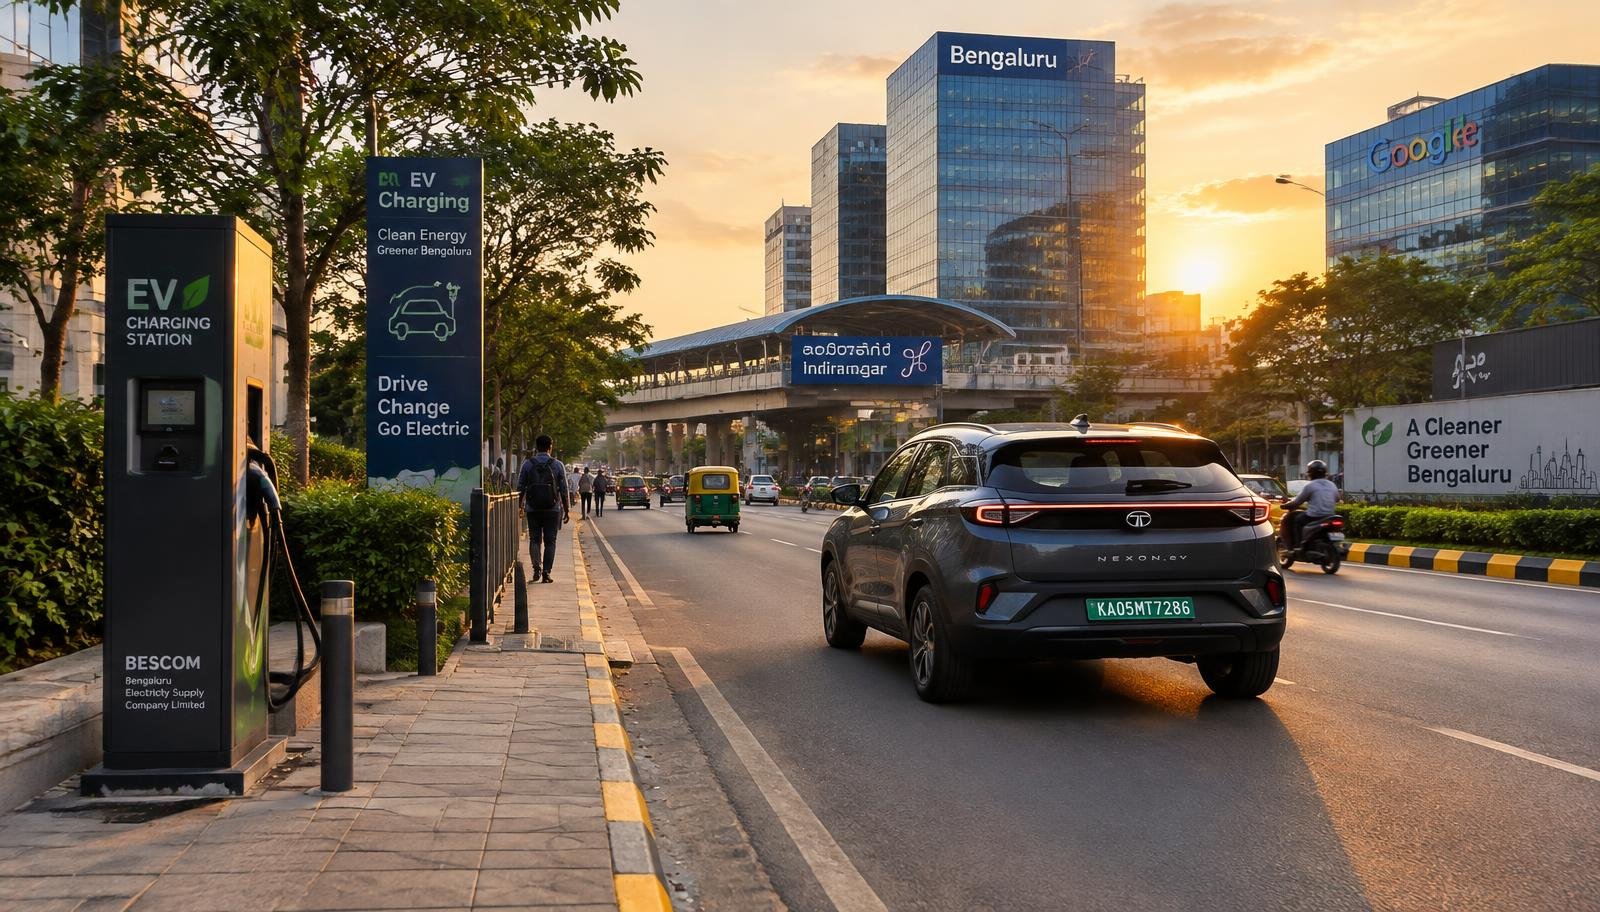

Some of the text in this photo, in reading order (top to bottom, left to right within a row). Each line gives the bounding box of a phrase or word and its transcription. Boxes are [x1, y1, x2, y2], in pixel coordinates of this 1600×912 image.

[950, 45, 1057, 70] Bengaluru
[410, 171, 437, 188] EV
[378, 191, 470, 213] Charging
[377, 228, 467, 245] Clean Energy
[377, 245, 419, 255] Greener
[127, 279, 178, 311] EV
[126, 316, 211, 330] CHARGING
[126, 333, 192, 346] STATION
[378, 374, 428, 392] Drive
[377, 398, 450, 419] Change
[377, 421, 470, 436] Go Electric
[1406, 417, 1502, 436] A Cleaner
[1407, 441, 1490, 459] Greener
[1408, 464, 1512, 488] Bengaluru
[1097, 600, 1191, 616] KA05MT7286
[125, 655, 201, 670] BESCOM
[172, 688, 205, 698] Supply
[125, 701, 169, 711] Company
